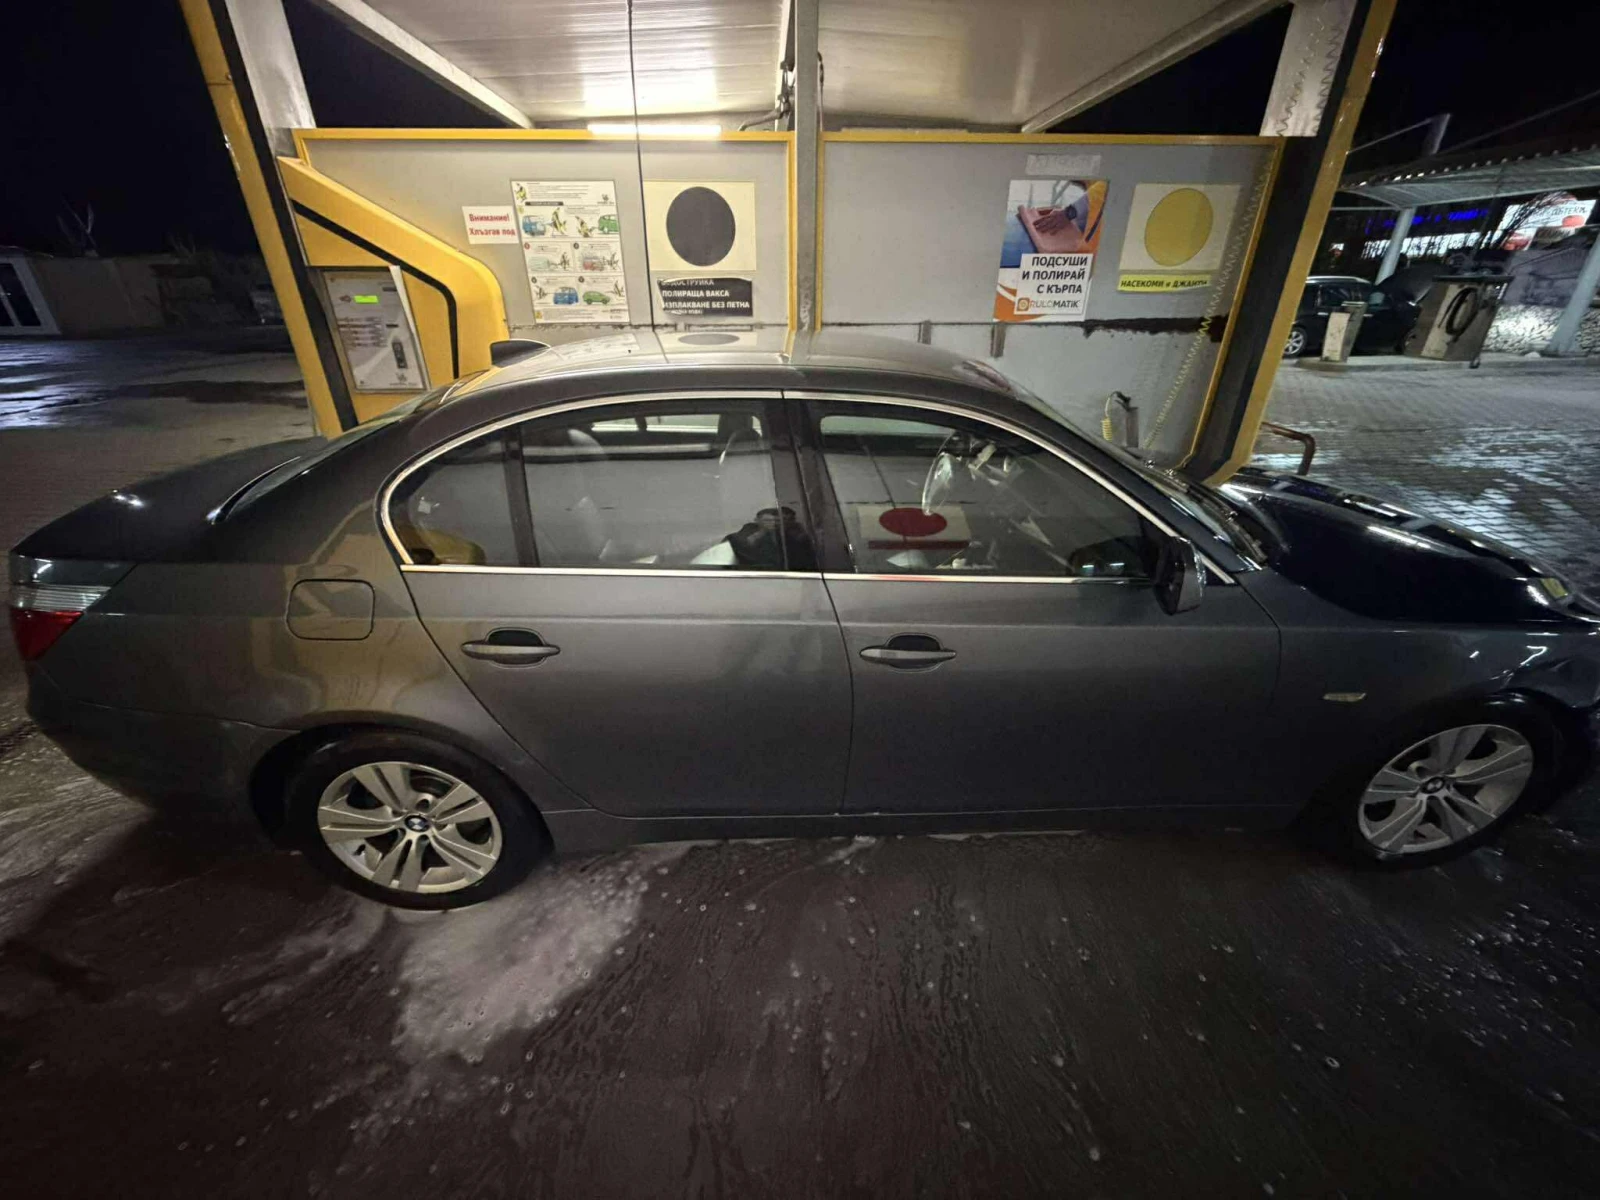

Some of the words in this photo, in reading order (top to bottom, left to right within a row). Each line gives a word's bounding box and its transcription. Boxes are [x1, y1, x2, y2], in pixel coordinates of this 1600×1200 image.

[469, 213, 510, 222] Внимание!
[469, 227, 500, 236] Хлъзгав
[502, 229, 516, 237] под
[1031, 256, 1088, 267] ПОДСУШИ
[1021, 270, 1030, 280] И
[1032, 267, 1086, 280] ПОЛИРАЙ
[1036, 284, 1044, 294] С
[1046, 284, 1083, 294] КЪРПА
[1120, 280, 1164, 288] НАСЕКОМИ
[662, 290, 704, 298] ПОЛИРАЩА
